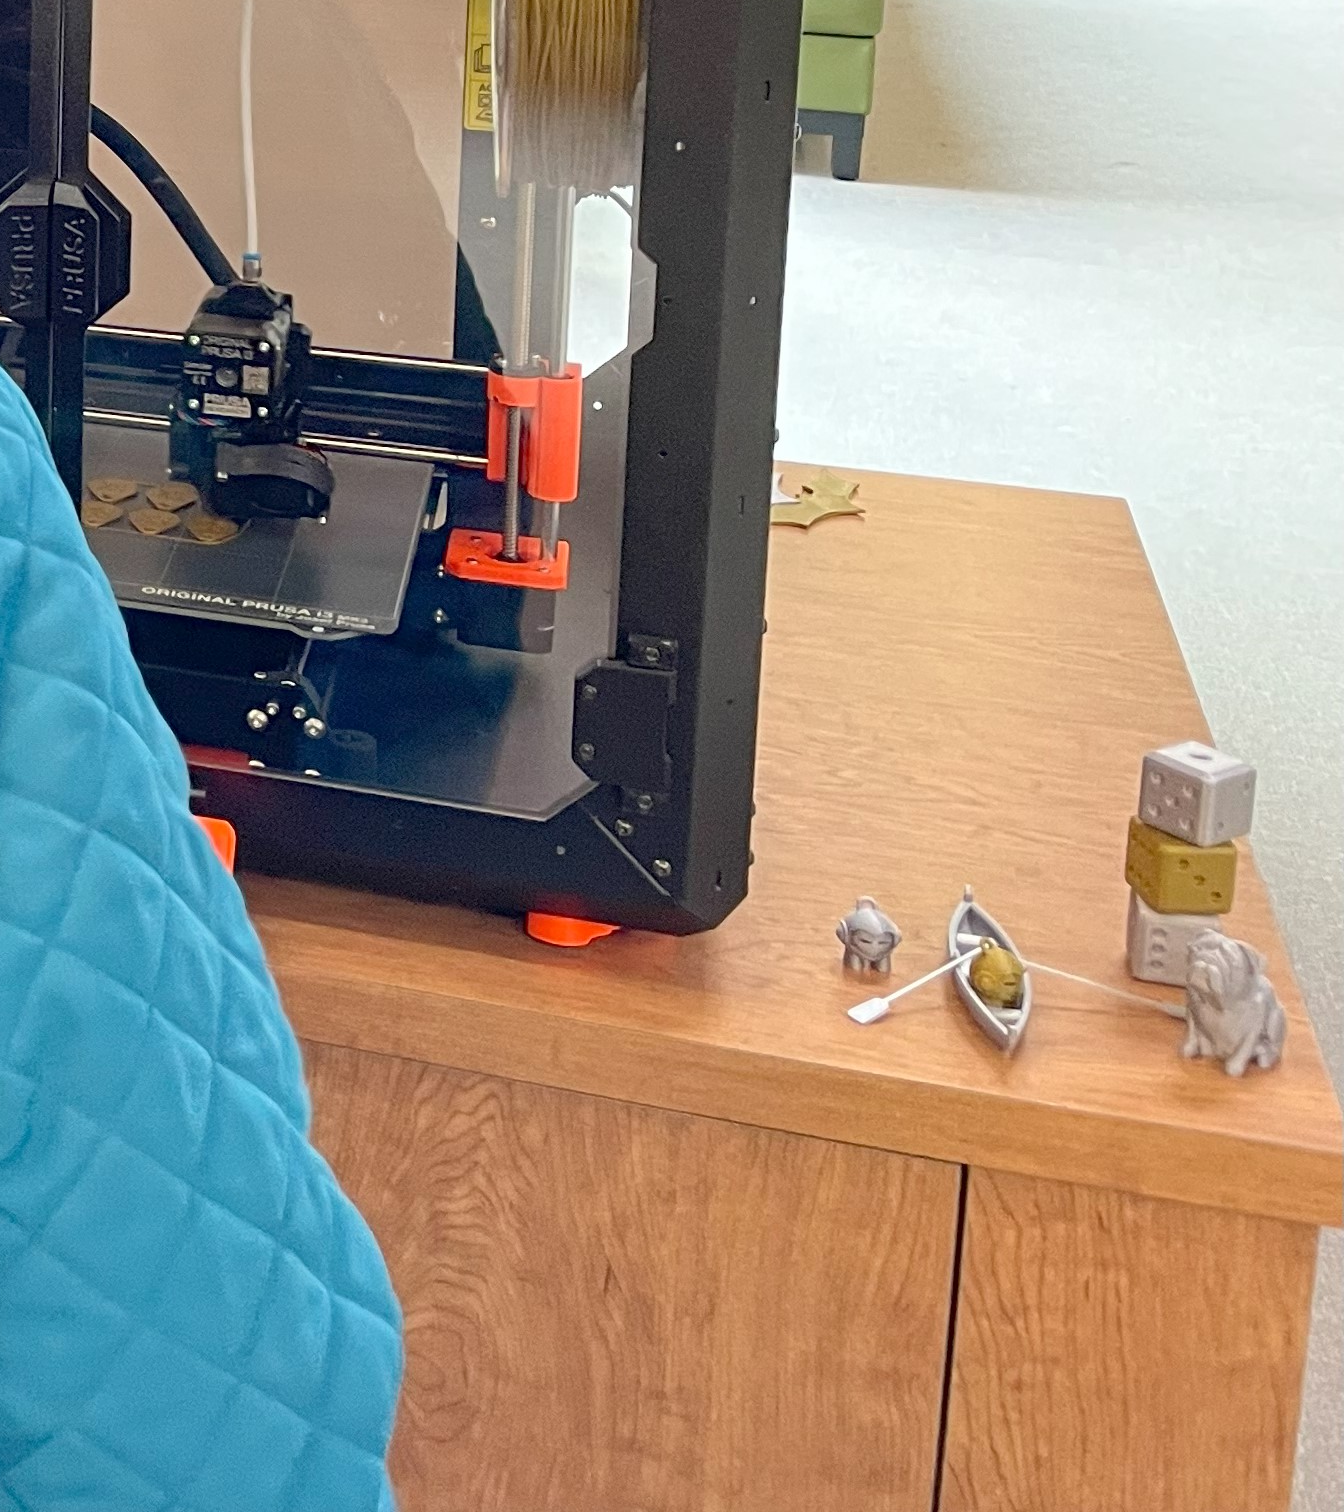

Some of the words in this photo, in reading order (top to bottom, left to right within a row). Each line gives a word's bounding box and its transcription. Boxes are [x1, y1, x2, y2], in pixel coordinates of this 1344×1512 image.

[10, 215, 35, 310] PRUSA
[141, 586, 237, 607] ORIGINAL
[242, 599, 311, 616] PRUSA
